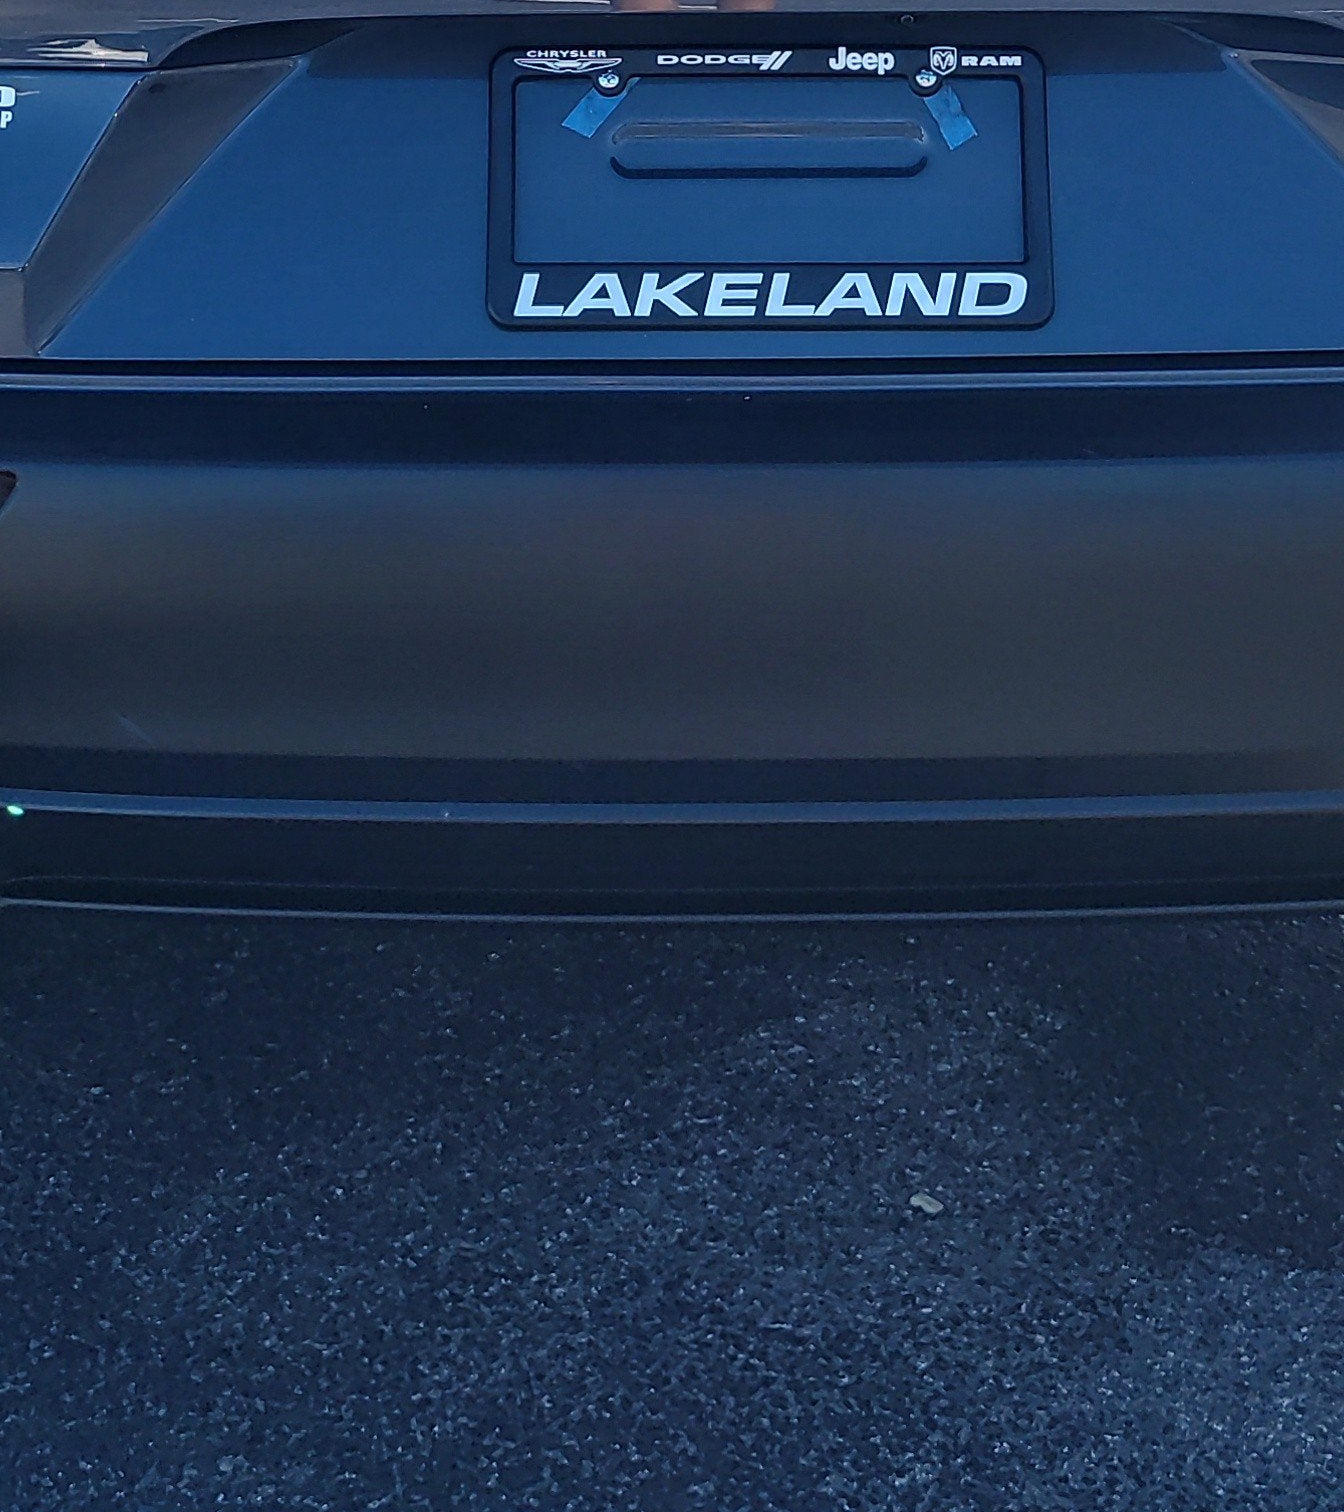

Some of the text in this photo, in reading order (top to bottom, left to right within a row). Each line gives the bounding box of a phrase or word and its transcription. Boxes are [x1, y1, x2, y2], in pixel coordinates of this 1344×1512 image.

[526, 47, 1022, 75] CHRYSLER DODGE Jeep RAM
[512, 272, 1028, 317] LAKELAND
